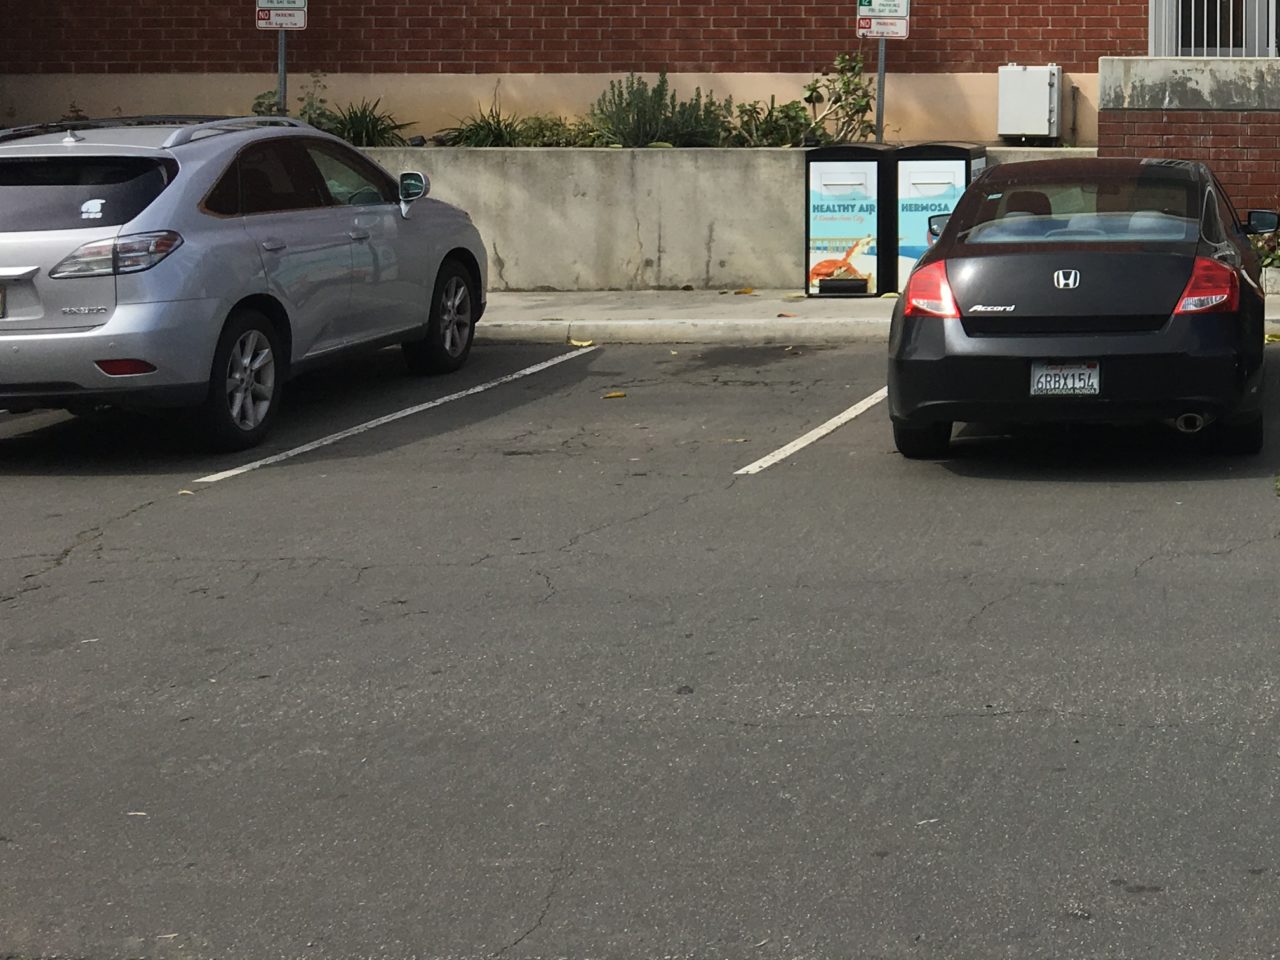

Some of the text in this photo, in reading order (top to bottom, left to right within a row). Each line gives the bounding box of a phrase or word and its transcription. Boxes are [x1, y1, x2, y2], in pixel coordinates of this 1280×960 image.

[259, 11, 270, 19] NO
[860, 19, 871, 28] NO
[812, 204, 876, 213] HEALTHY AIR
[901, 203, 949, 212] HERMOSA
[969, 304, 1016, 312] Accord
[1036, 372, 1095, 390] 6RBX154
